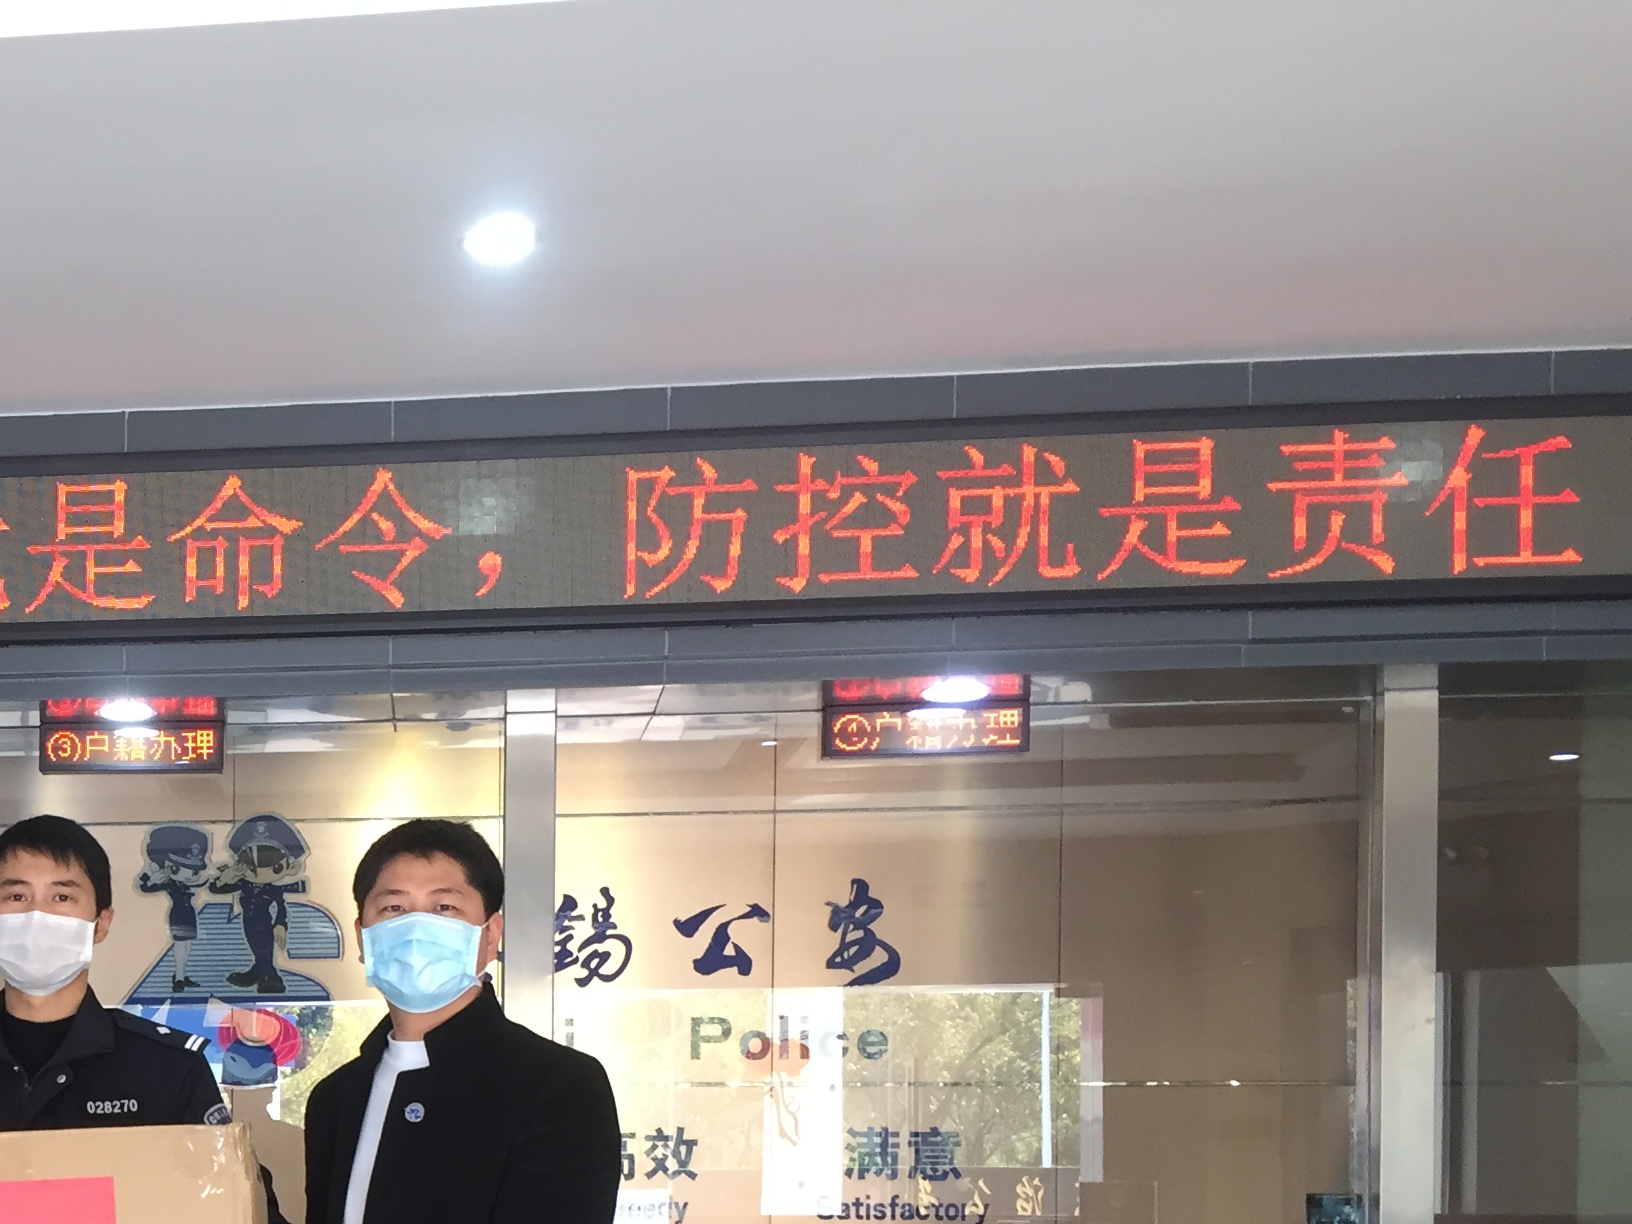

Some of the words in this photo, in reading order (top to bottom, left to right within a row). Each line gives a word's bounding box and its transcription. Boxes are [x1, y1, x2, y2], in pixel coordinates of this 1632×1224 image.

[689, 1015, 889, 1061] Police
[86, 1099, 138, 1114] 028270
[844, 1126, 963, 1182] 满意
